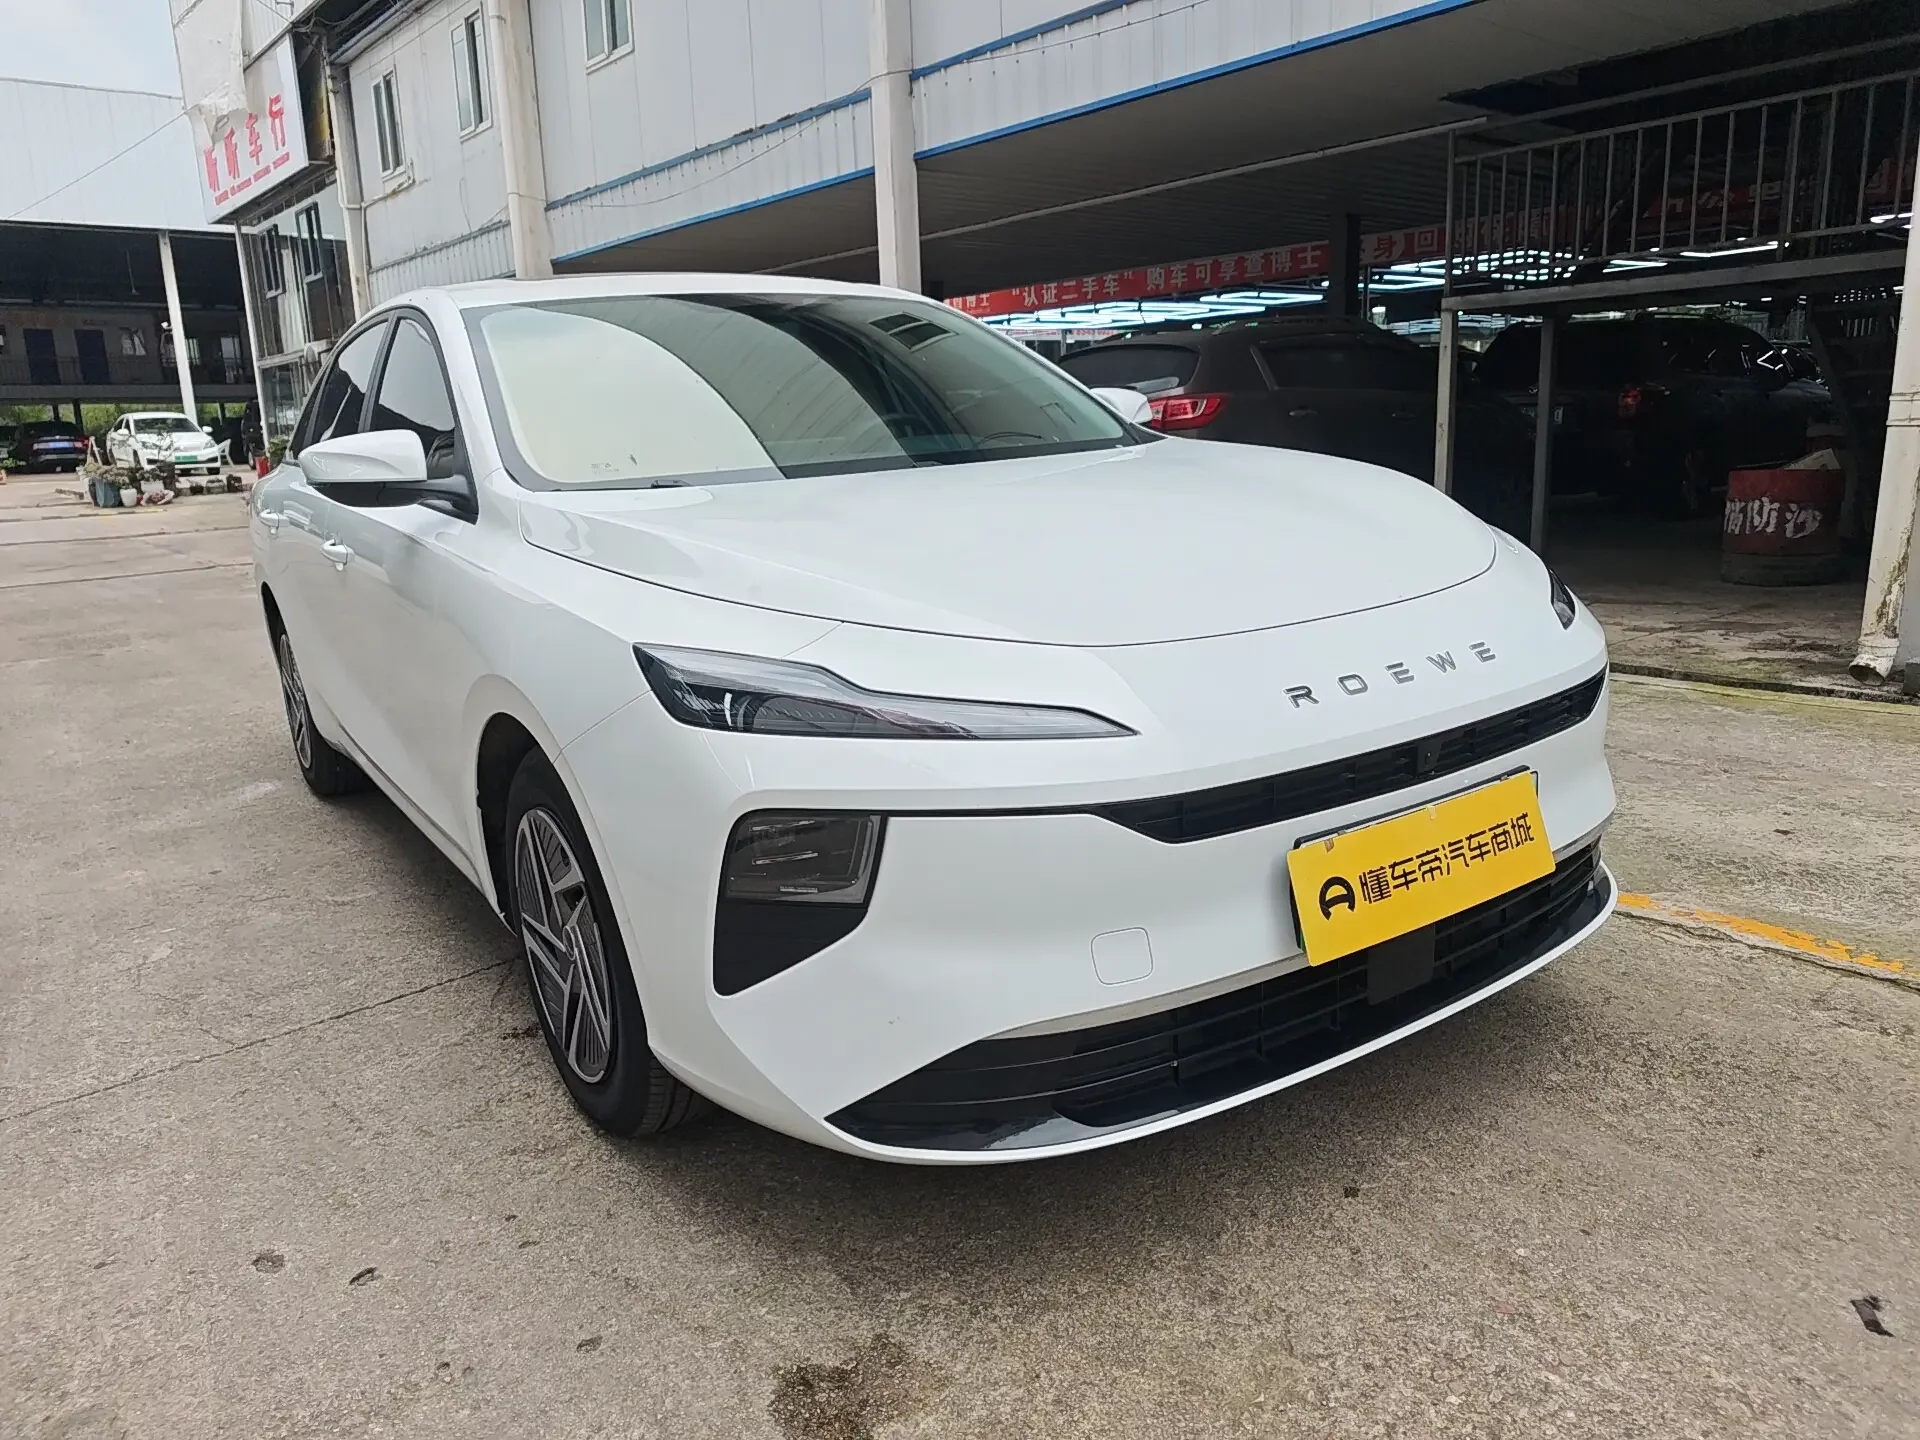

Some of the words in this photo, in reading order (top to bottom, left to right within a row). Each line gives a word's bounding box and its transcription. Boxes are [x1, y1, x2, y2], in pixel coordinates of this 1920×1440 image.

[1146, 245, 1322, 291] 购车可享查博士
[1723, 495, 1824, 540] 消防沙
[1284, 641, 1496, 708] ROEWE
[1358, 812, 1535, 905] 懂车帝汽车商城
